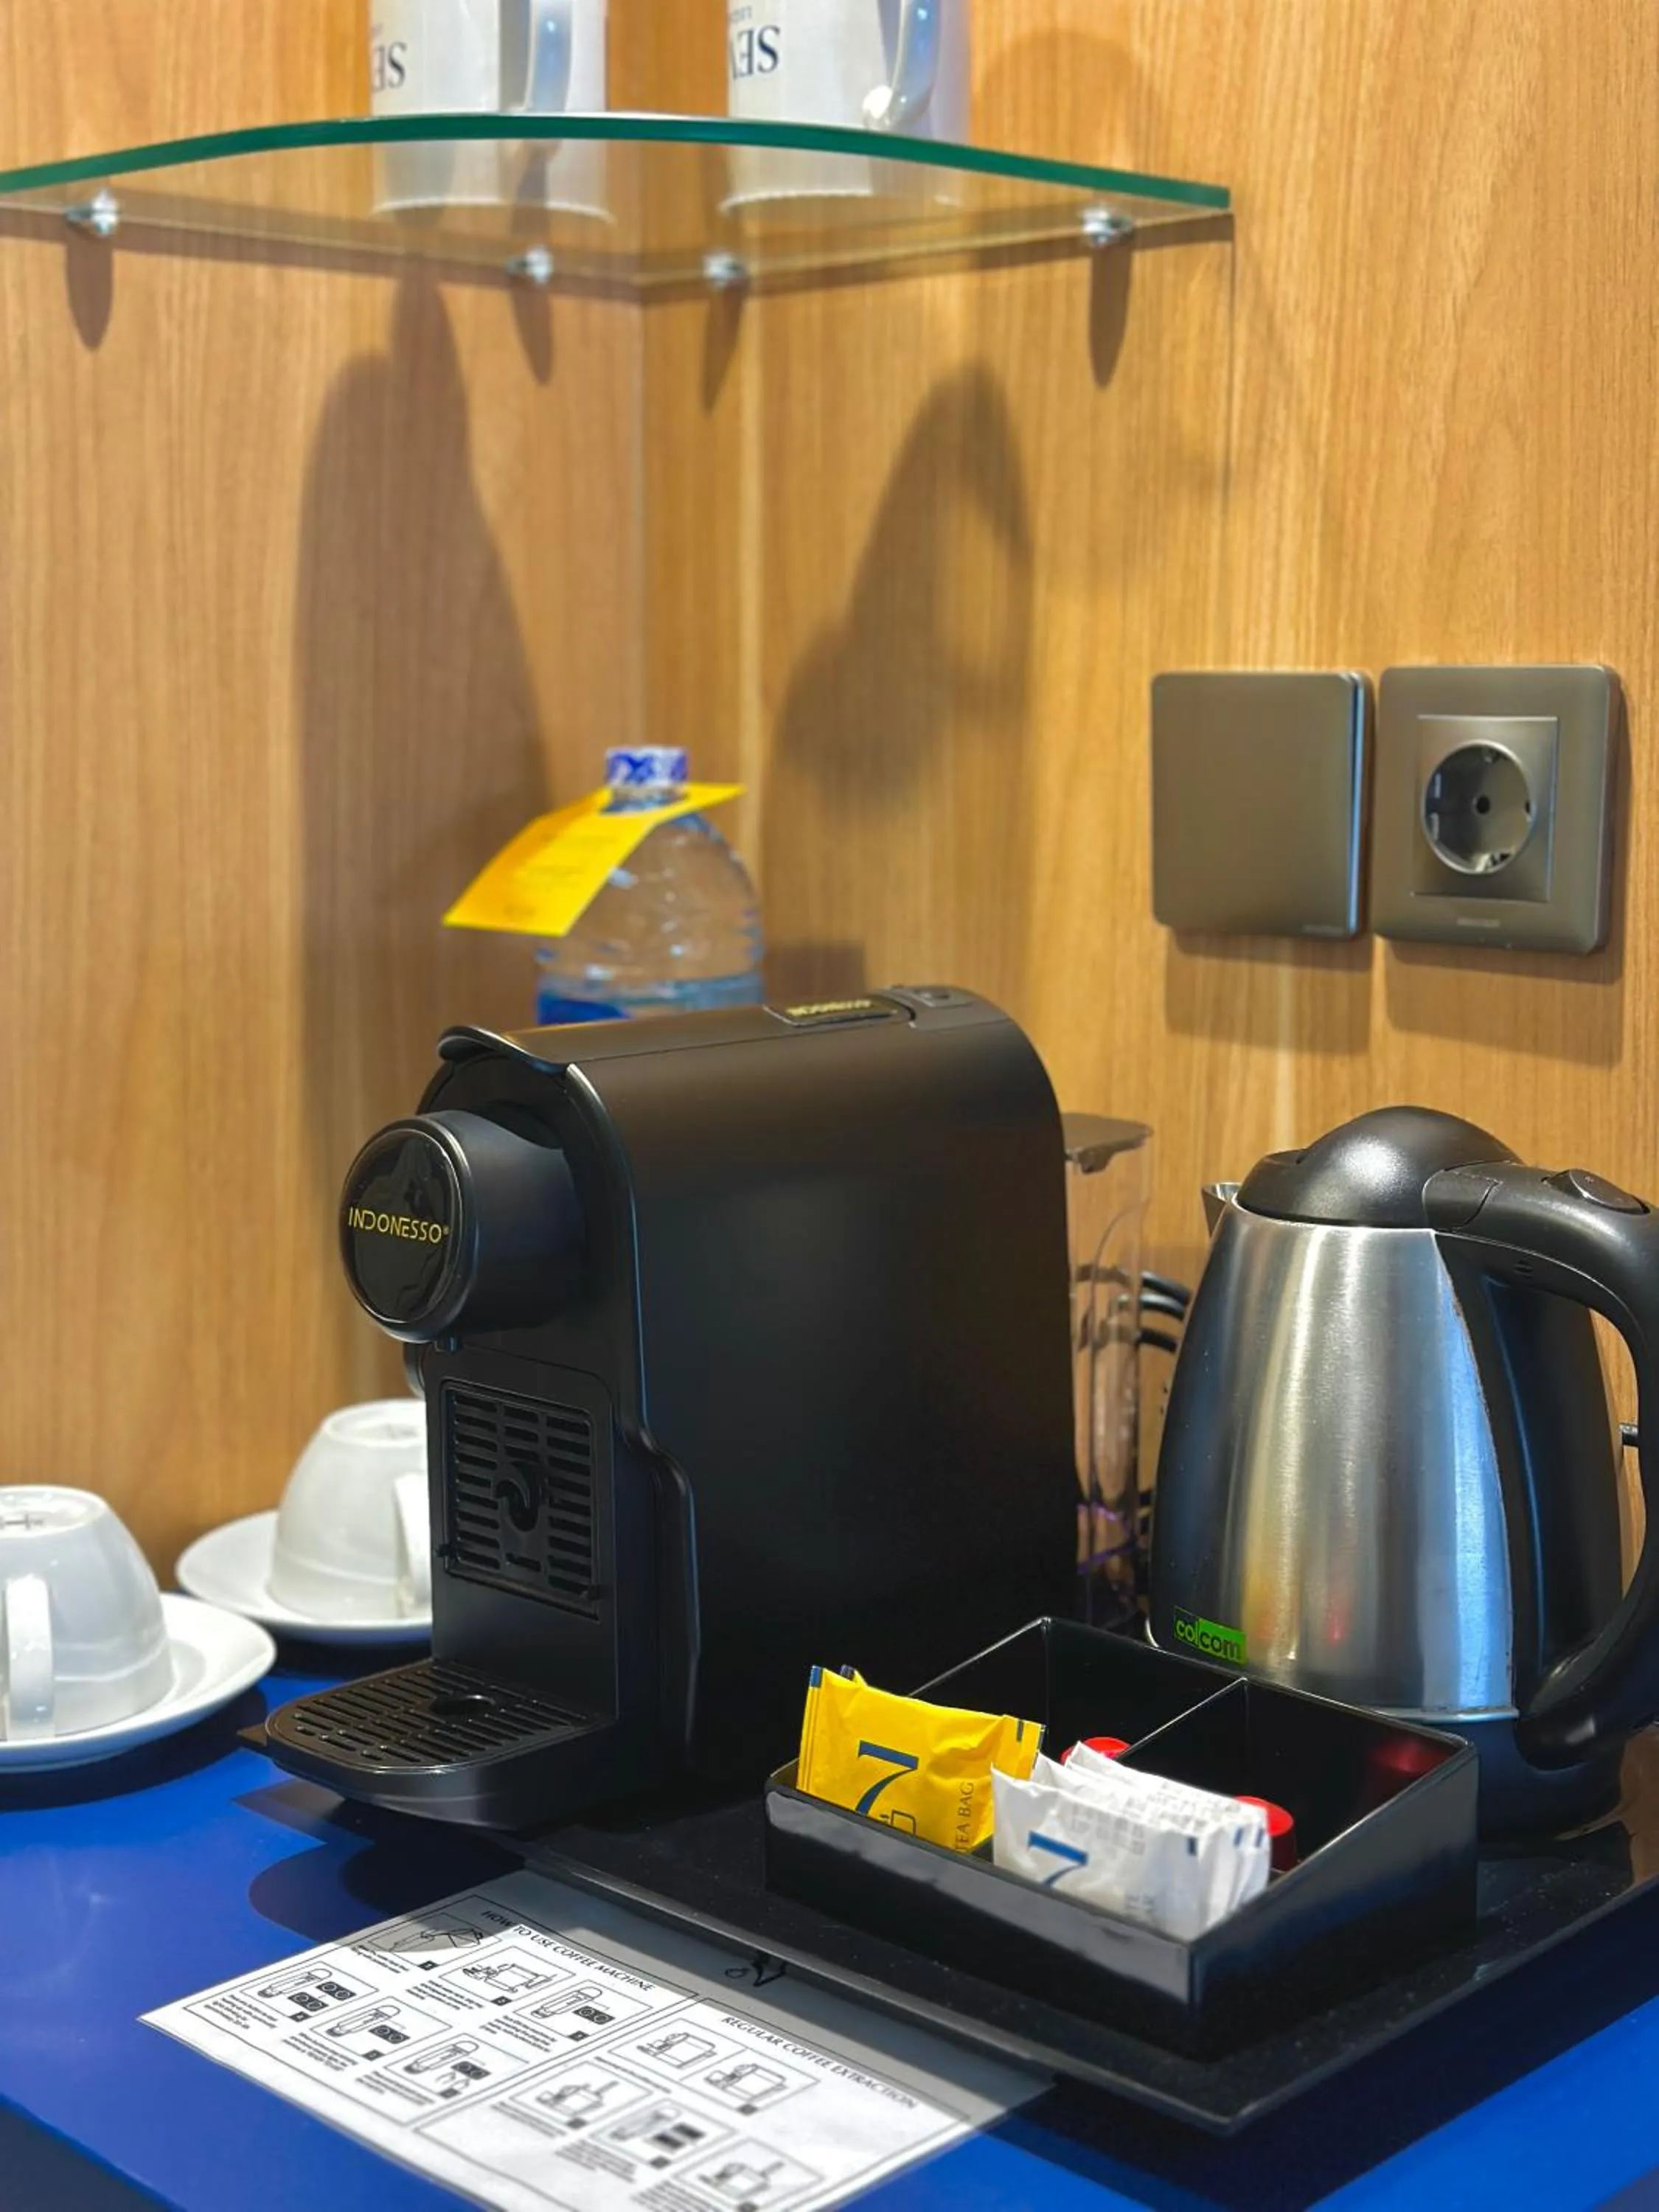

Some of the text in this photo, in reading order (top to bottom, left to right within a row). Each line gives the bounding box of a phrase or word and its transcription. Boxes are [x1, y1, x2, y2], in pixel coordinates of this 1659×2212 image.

[349, 1206, 442, 1244] INDONESSO
[857, 1739, 919, 1817] 7
[955, 1781, 974, 1851] TEA BAG
[1027, 1830, 1088, 1889] 7
[481, 1910, 655, 1992] HOW TO USE COFFEE MACHINE
[721, 2015, 920, 2110] REGULAR COFFEE EXTRACTION
